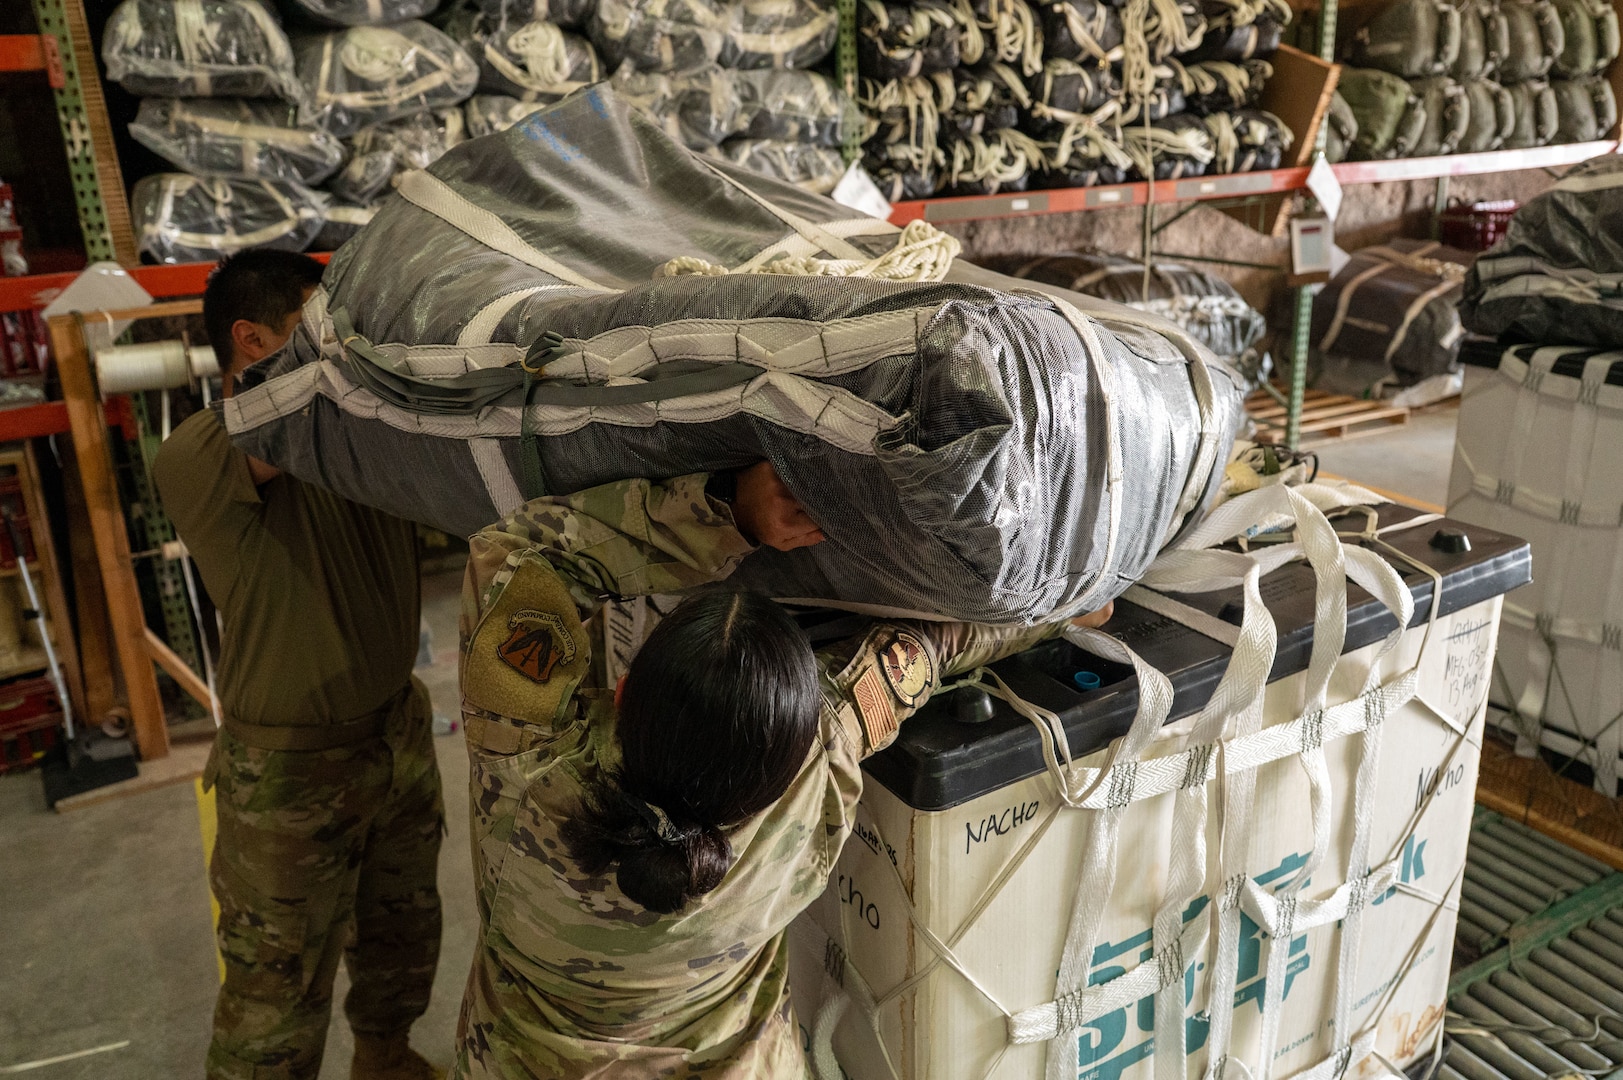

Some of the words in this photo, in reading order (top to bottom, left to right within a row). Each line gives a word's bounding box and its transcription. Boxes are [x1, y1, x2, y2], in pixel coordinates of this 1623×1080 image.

[1414, 763, 1464, 811] Naho
[966, 801, 1040, 855] NACHO
[839, 874, 880, 930] cho
[1273, 1031, 1314, 1061] 8.84.boxes
